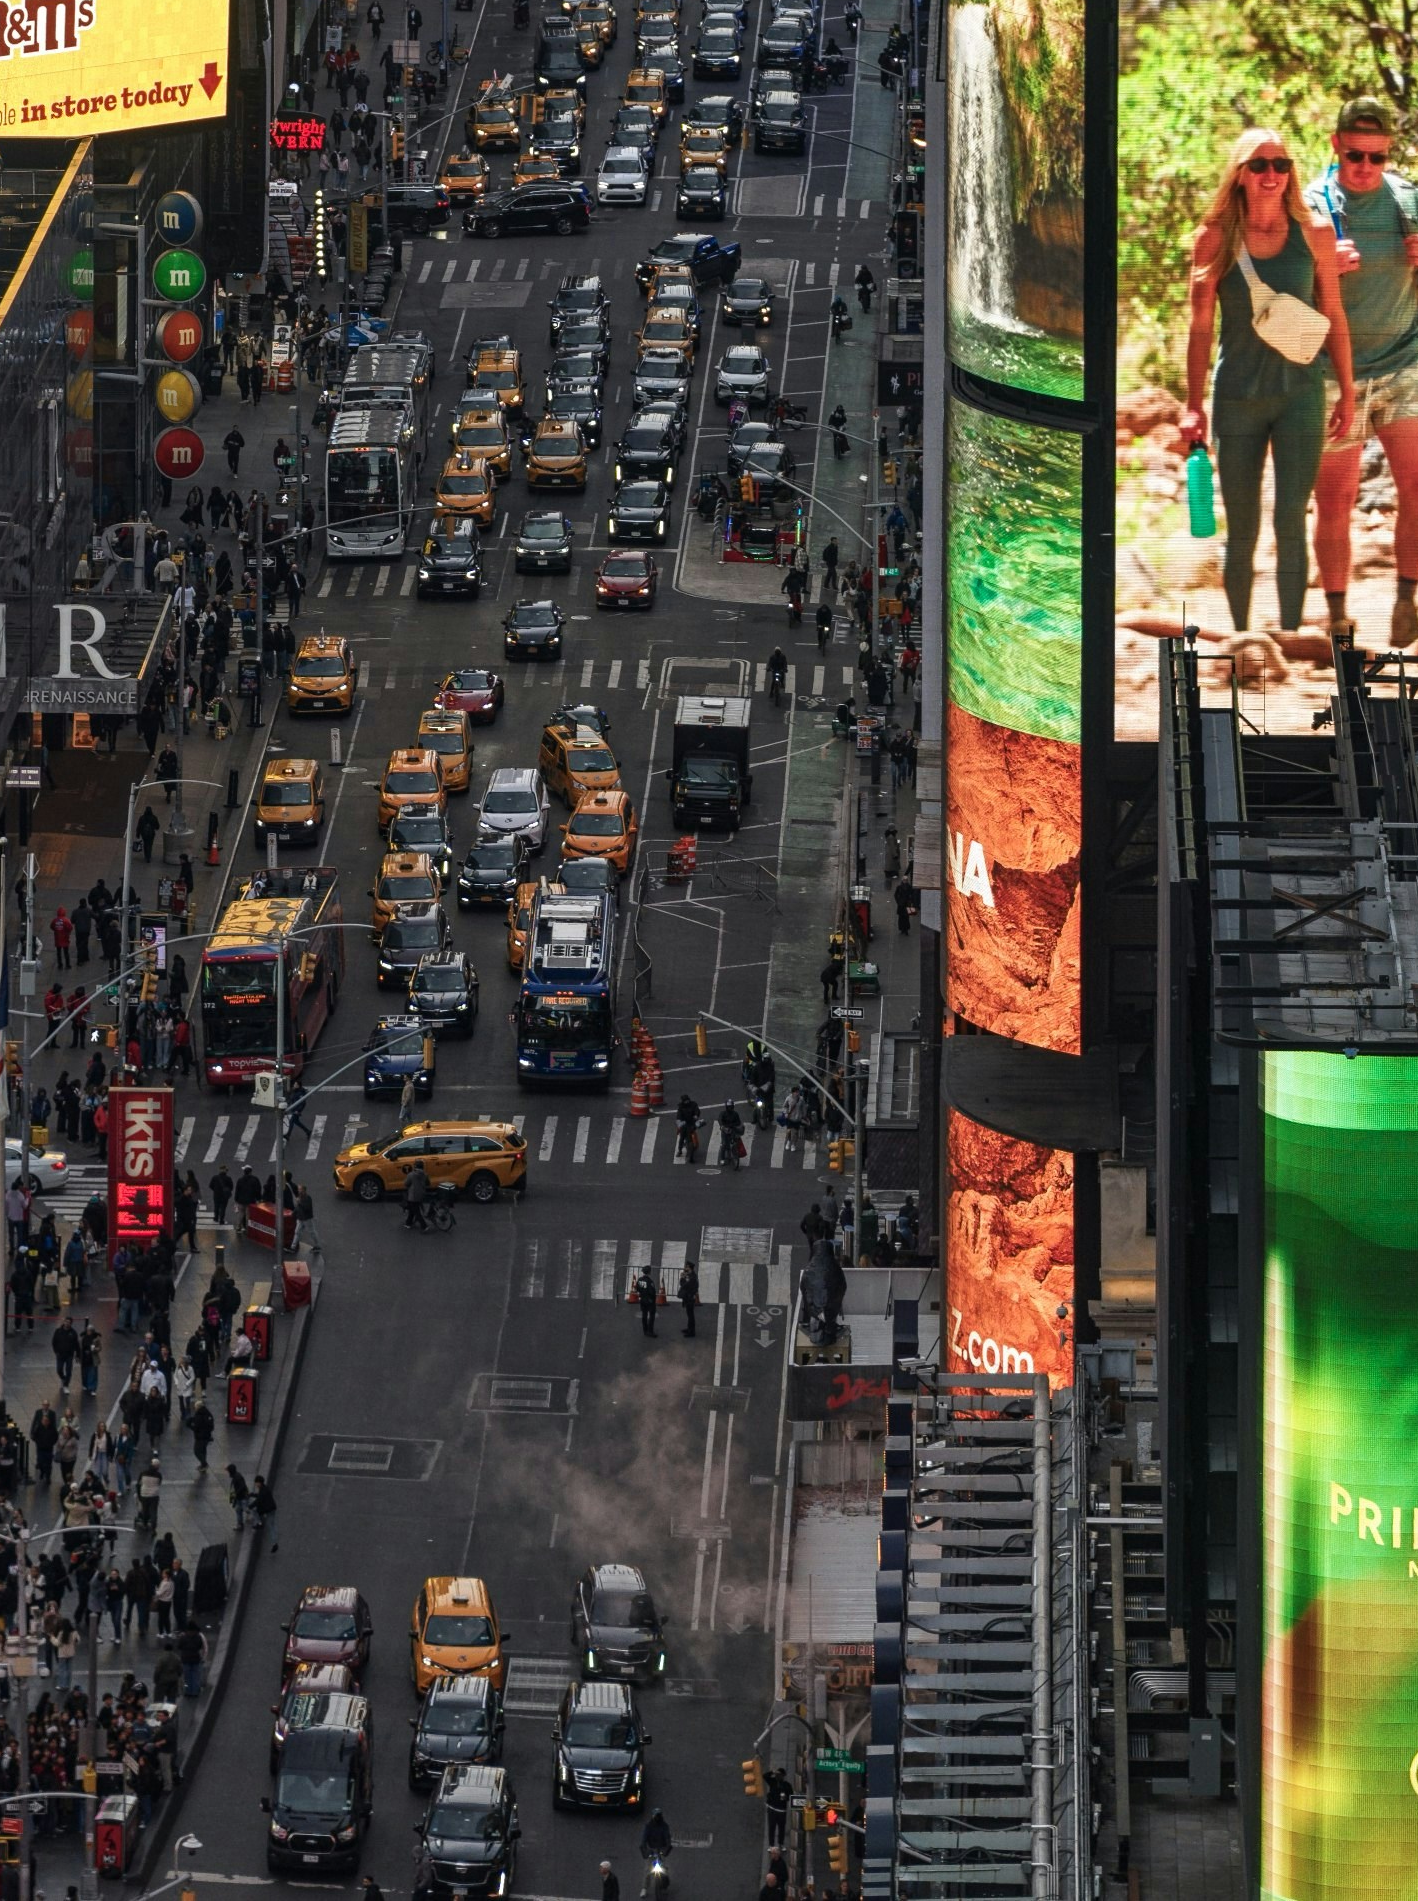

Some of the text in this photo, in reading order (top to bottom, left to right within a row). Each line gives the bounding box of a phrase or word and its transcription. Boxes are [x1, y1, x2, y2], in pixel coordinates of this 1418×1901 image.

[20, 81, 194, 125] in store today
[51, 603, 132, 680] R
[123, 1097, 164, 1178] tkts
